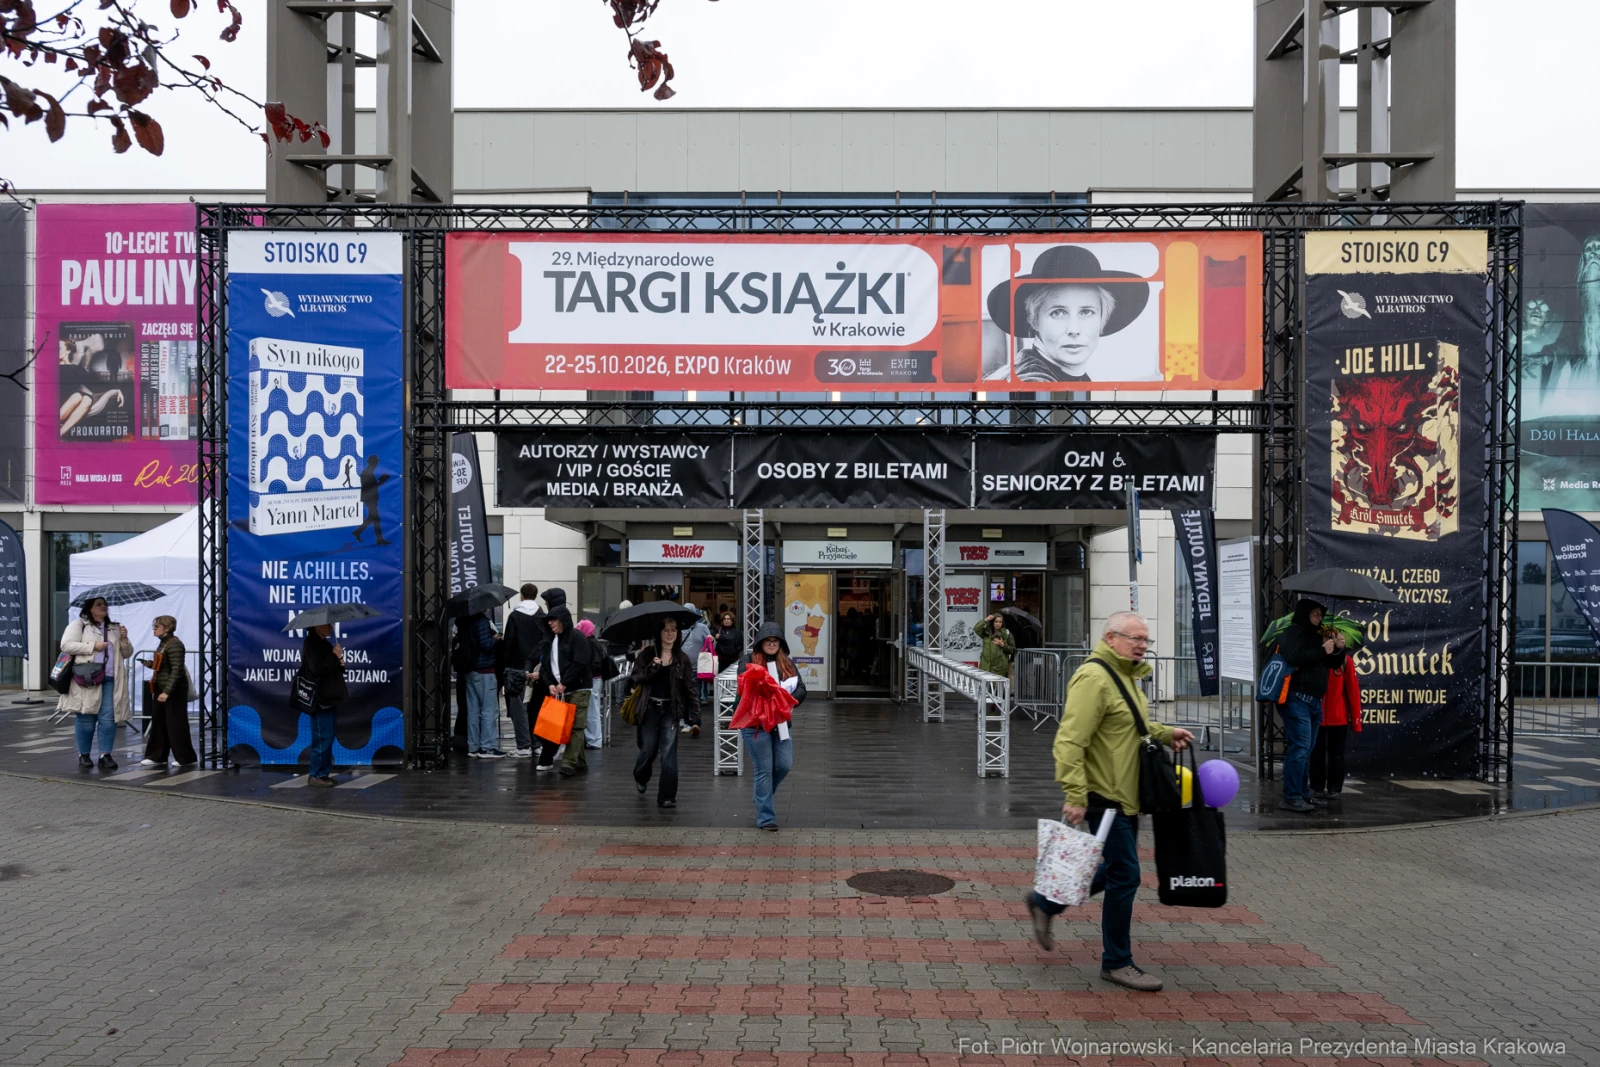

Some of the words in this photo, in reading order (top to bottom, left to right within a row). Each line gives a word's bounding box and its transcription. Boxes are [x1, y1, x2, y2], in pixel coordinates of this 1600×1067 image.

[105, 231, 169, 254] 10-LECIE
[264, 241, 339, 264] STOISKO
[346, 242, 368, 264] C9
[551, 251, 574, 267] 29.
[576, 250, 715, 269] Międzynarodowe
[1341, 241, 1419, 263] STOISKO
[1426, 241, 1450, 263] C9
[61, 259, 197, 306] PAULINY
[297, 294, 373, 304] WYDAWNICTWO
[543, 270, 691, 314] TARGI
[705, 261, 906, 323] KSIĄŻKI
[1375, 294, 1454, 304] WYDAWNICTWO
[297, 304, 347, 313] ALBATROS
[1375, 304, 1426, 313] ALBATROS
[142, 323, 178, 338] ZACZĘŁO
[180, 323, 193, 338] SIĘ
[812, 326, 828, 337] w
[829, 321, 905, 337] Krakowie
[141, 344, 149, 381] KOMISARZ
[266, 342, 301, 368] Syn
[306, 347, 361, 372] nikogo
[890, 358, 918, 369] EXPO
[1341, 346, 1375, 375] JOE
[1380, 342, 1426, 373] HILL
[544, 354, 671, 378] 22-25.10.2026,
[674, 355, 719, 376] EXPO
[723, 354, 792, 376] Kraków
[70, 425, 129, 437] PROKURATOR
[1530, 429, 1557, 441] D30
[519, 445, 599, 459] AUTORZY
[602, 445, 609, 458] /
[612, 445, 710, 460] WYSTAWCY
[1064, 450, 1105, 468] OzN
[134, 459, 172, 488] Rok
[566, 464, 593, 478] VIP
[606, 461, 672, 478] GOŚCIE
[757, 462, 828, 479] OSOBY
[834, 463, 848, 479] Z
[853, 462, 948, 479] BILETAMI
[546, 482, 600, 496] MEDIA
[613, 479, 684, 497] BRANŻA
[982, 474, 1089, 491] SENIORZY
[1090, 475, 1104, 491] Z
[1560, 480, 1590, 489] Media
[267, 507, 307, 526] Yann
[312, 501, 360, 522] Martel
[1349, 507, 1372, 523] Król
[1376, 509, 1415, 526] Smutek
[661, 544, 705, 558] Asteriks
[818, 551, 858, 561] Przyjaciele
[826, 545, 848, 554] Kubuś
[262, 560, 289, 580] NIE
[293, 561, 374, 580] ACHILLES.
[1402, 569, 1441, 584] CZEGO
[269, 585, 296, 604] NIE
[301, 586, 367, 605] HEKTOR.
[262, 648, 302, 663] WOJNA
[1352, 641, 1455, 676] Smutek
[242, 668, 281, 682] JAKIEJ
[1360, 689, 1404, 704] SPEŁNI
[1407, 689, 1447, 704] TWOJE
